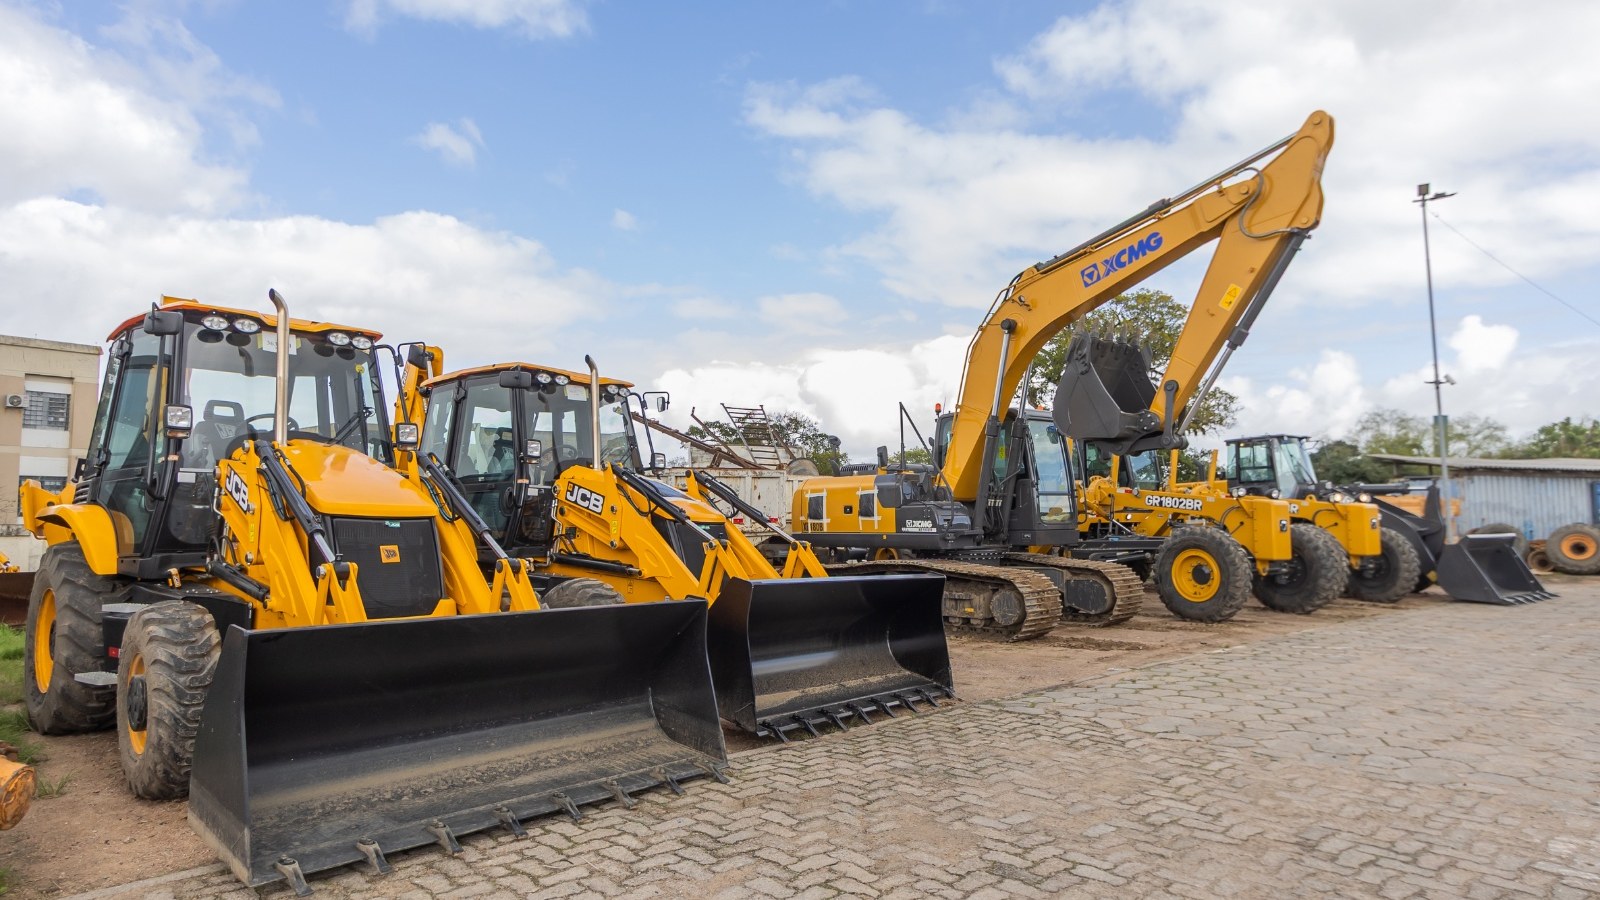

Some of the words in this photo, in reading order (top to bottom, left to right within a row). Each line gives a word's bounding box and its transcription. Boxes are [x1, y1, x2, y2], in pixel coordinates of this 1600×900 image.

[1101, 232, 1163, 279] XCMG
[225, 469, 249, 512] JCB
[566, 485, 604, 514] JCB
[1145, 494, 1203, 511] GR1802BR
[912, 520, 933, 528] XCMG
